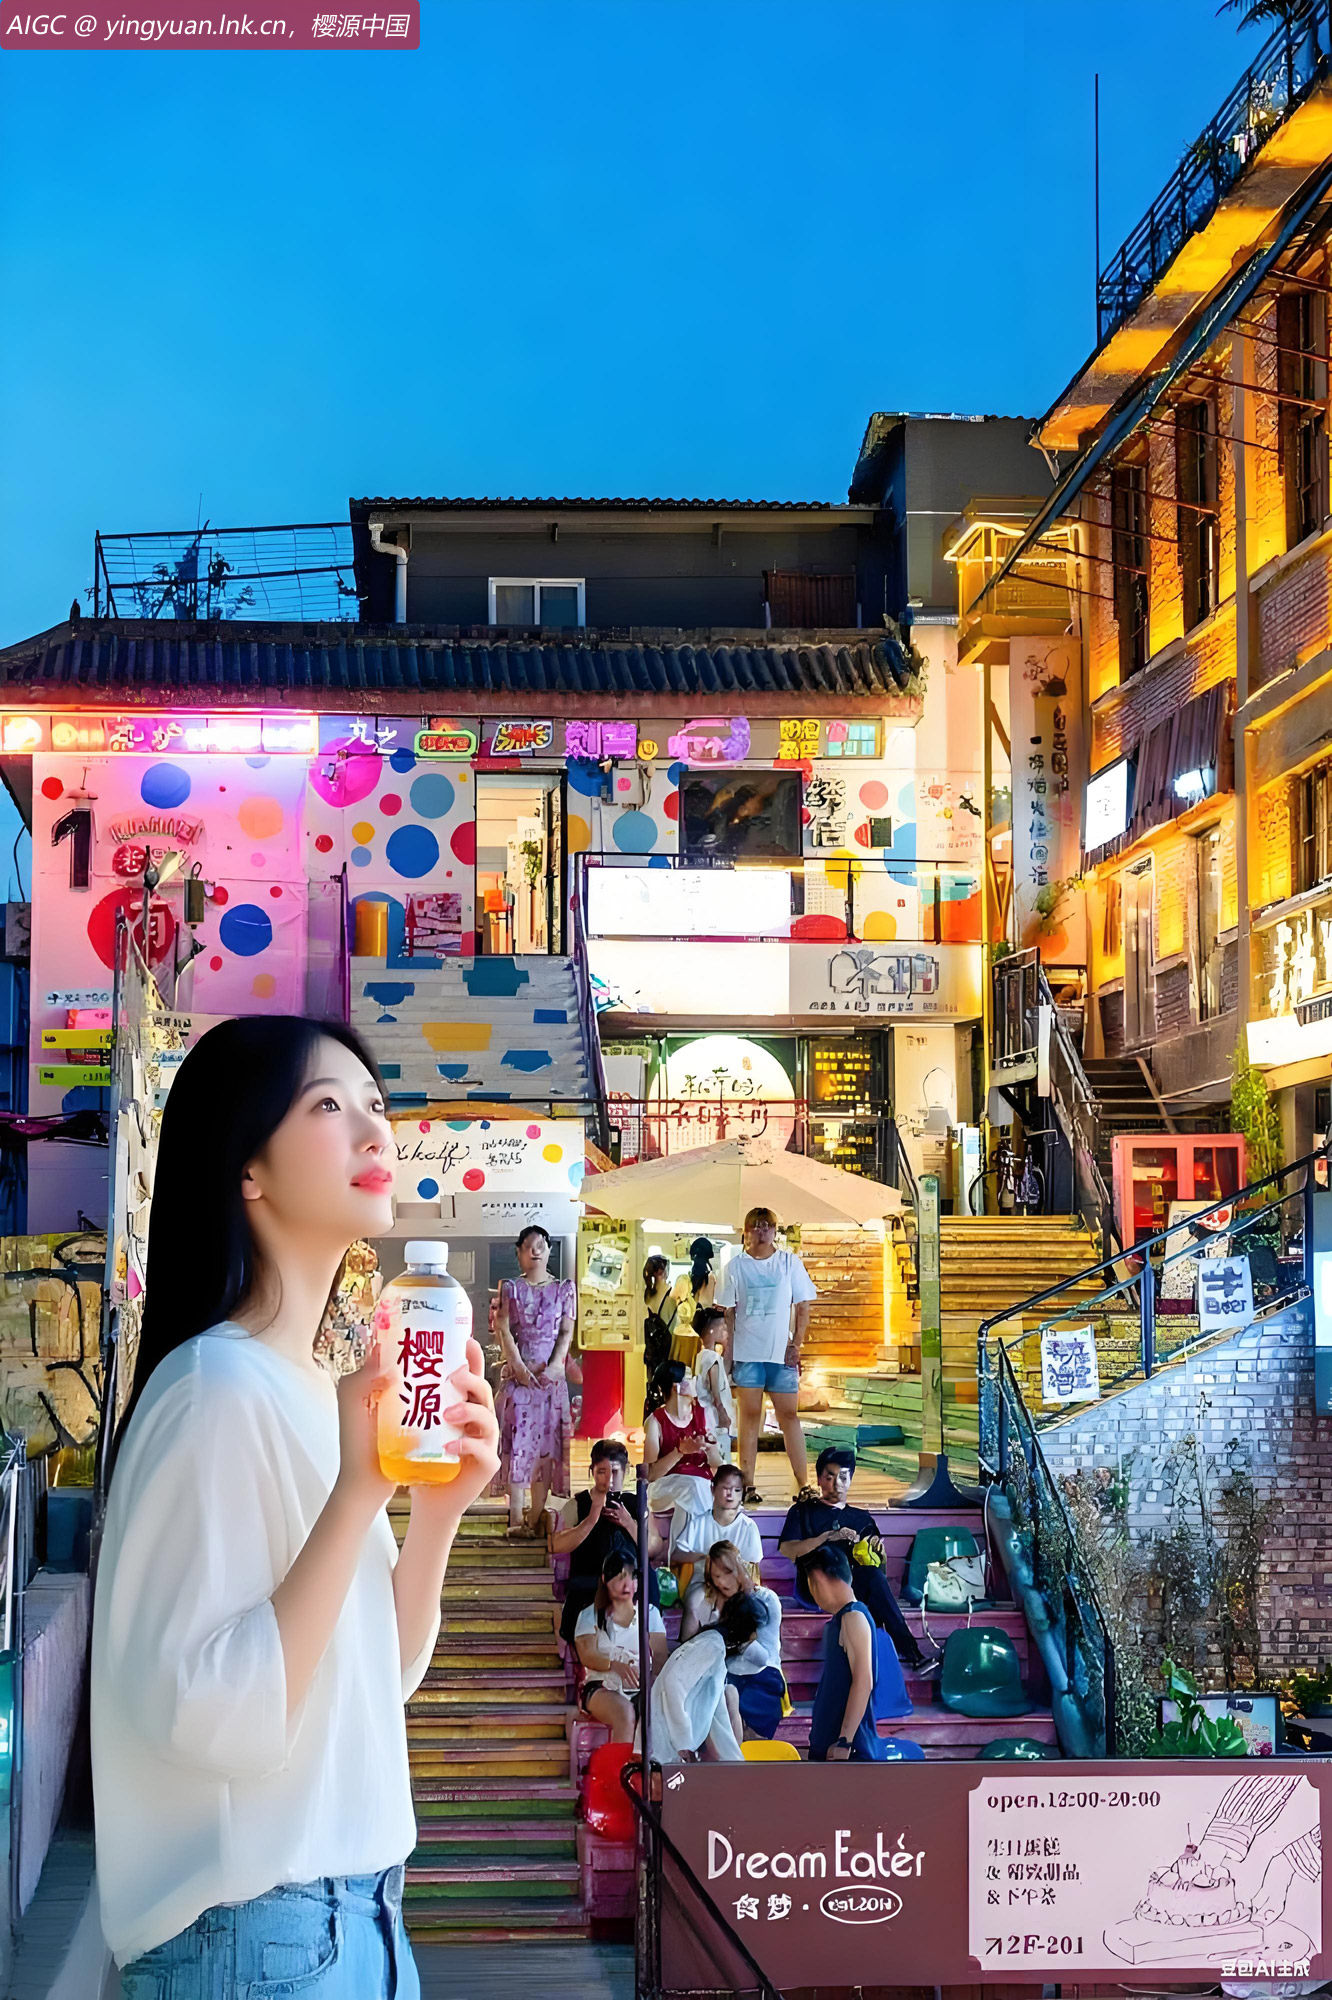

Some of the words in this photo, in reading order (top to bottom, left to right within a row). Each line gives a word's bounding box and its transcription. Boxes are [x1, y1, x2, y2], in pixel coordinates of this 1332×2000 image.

[397, 1327, 444, 1430] 樱源
[707, 1829, 827, 1880] Dream
[1007, 1934, 1084, 1955] 2F-201
